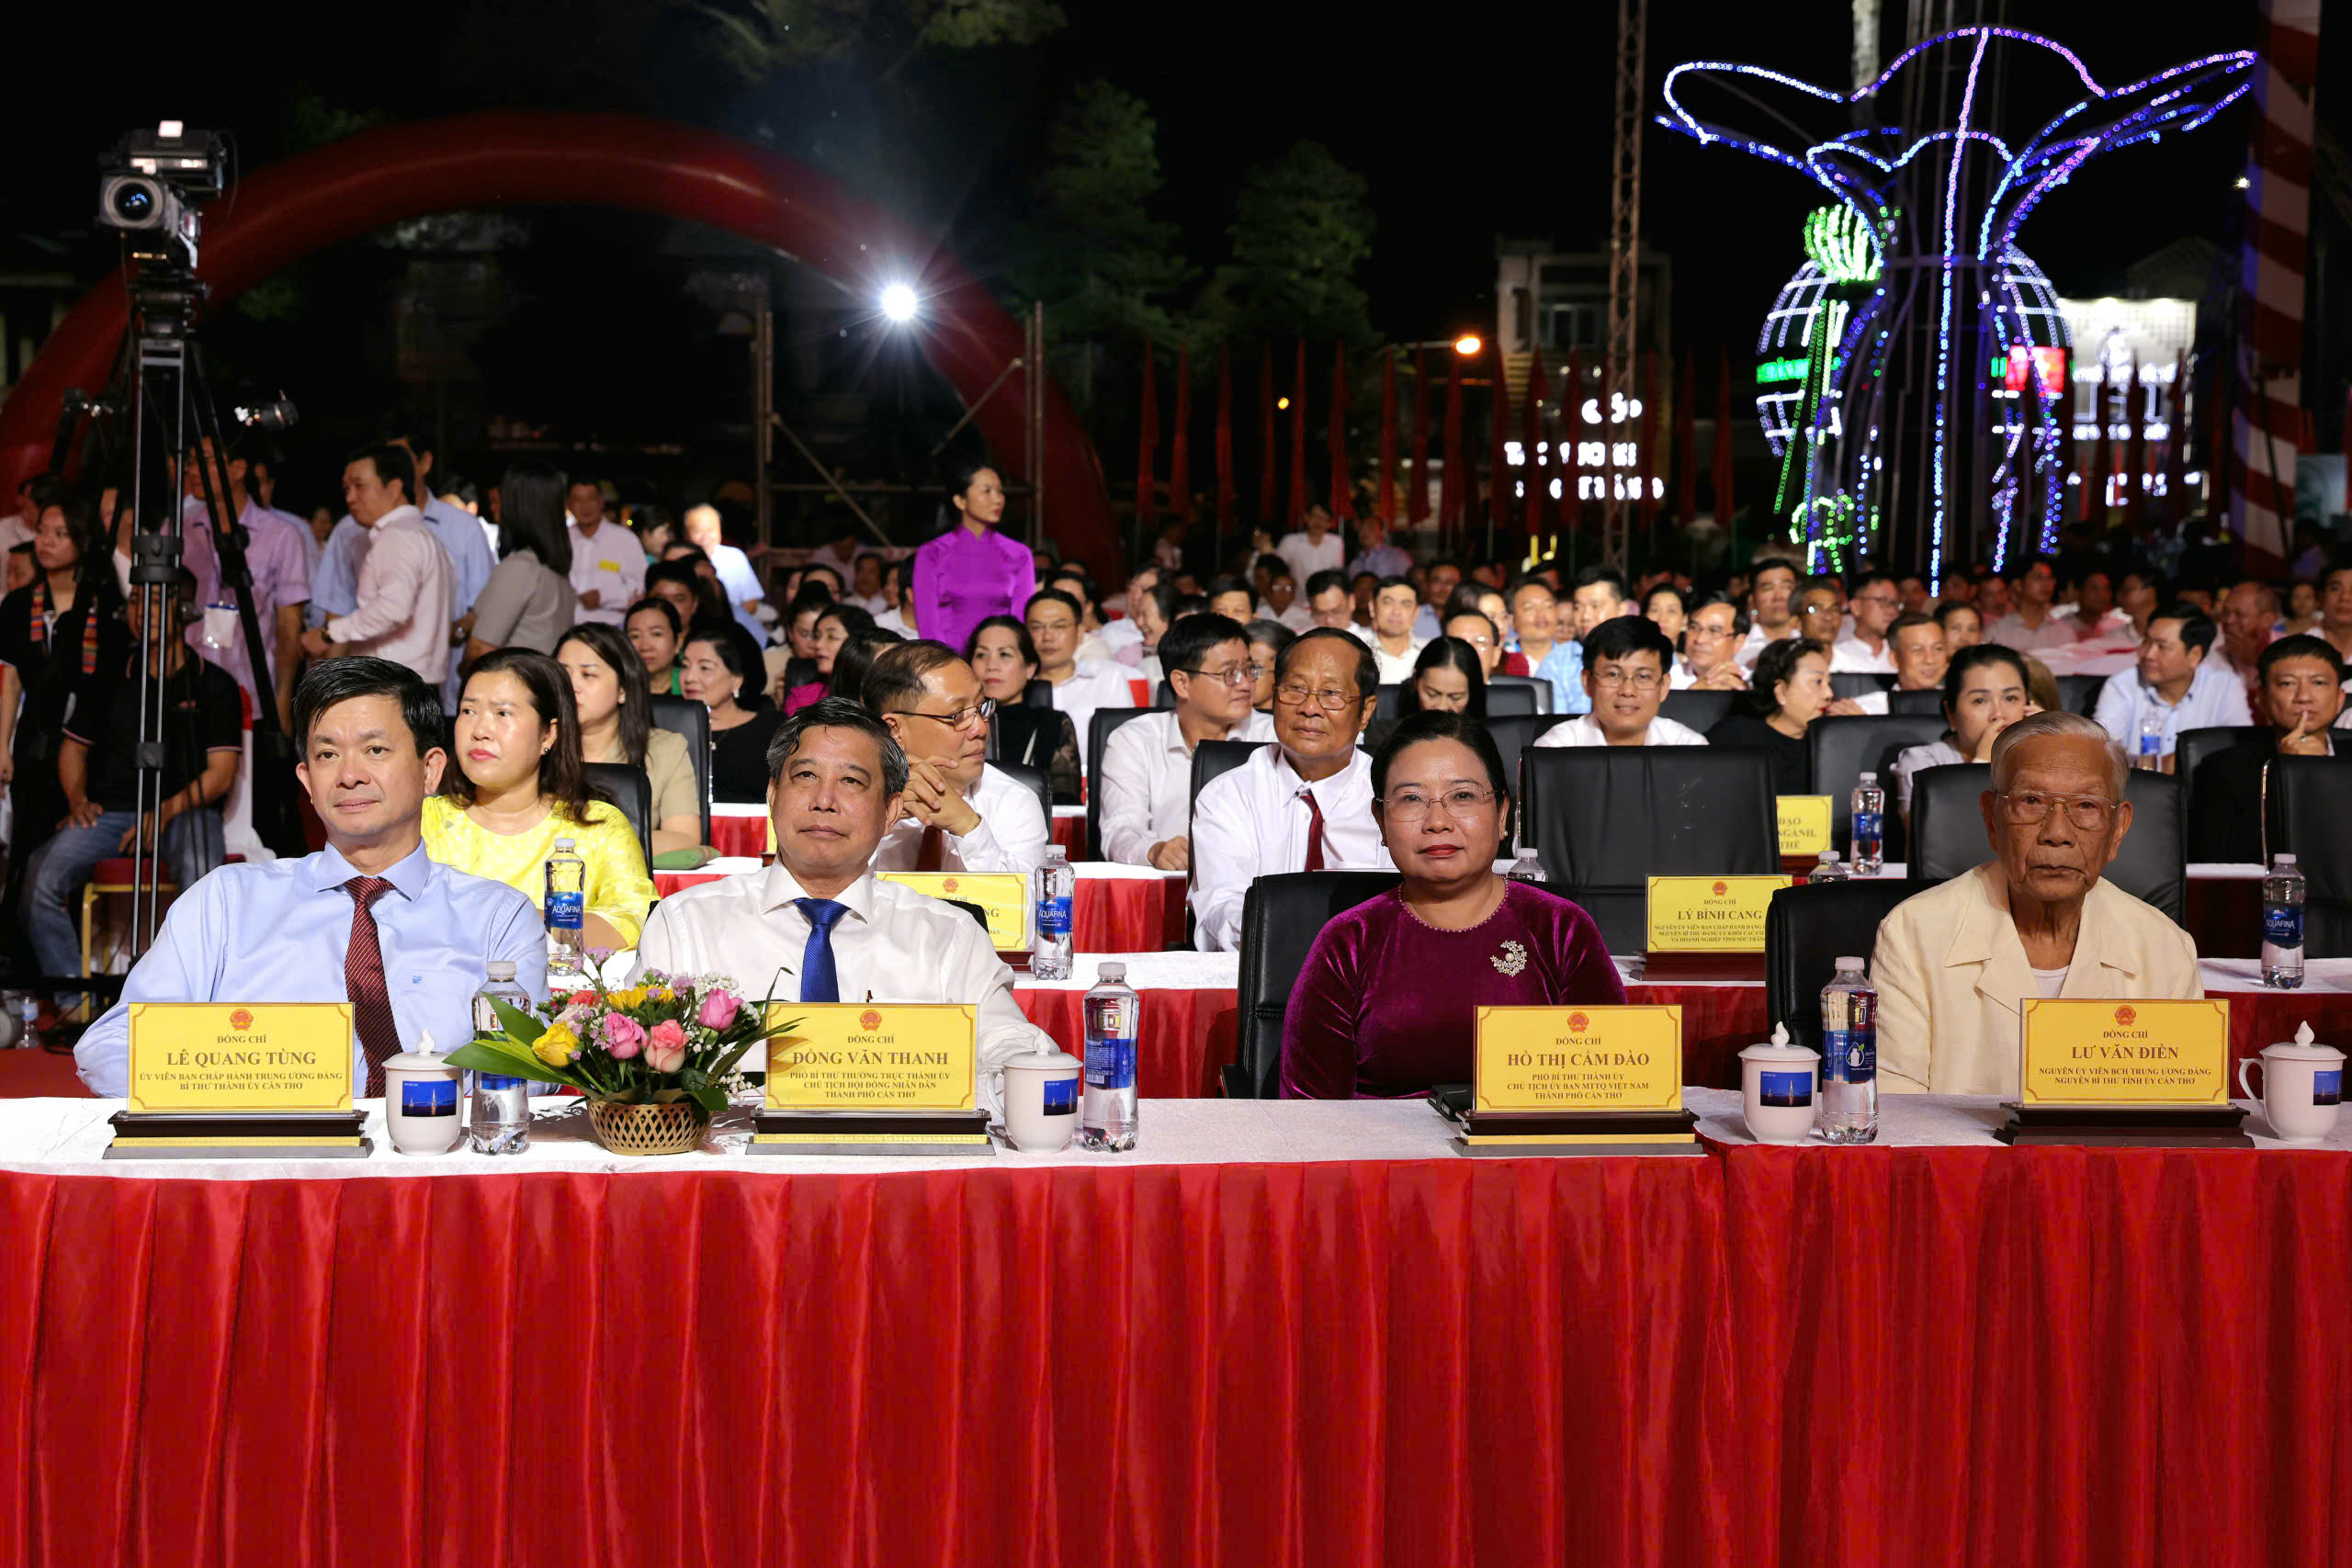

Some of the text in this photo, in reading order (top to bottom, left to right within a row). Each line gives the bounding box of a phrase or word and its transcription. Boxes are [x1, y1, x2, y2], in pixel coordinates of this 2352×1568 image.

[552, 905, 581, 914] AQUAFINA
[1038, 909, 1068, 919] AQUAFINA
[1678, 908, 1762, 920] LÝ BÌNH CANG
[2266, 919, 2295, 929] AQUAFINA
[217, 1034, 266, 1044] ĐỒNG CHÍ
[2103, 1029, 2148, 1039] ĐỒNG CHÍ
[847, 1035, 895, 1044] ĐỒNG CHÍ
[1555, 1036, 1601, 1045] ĐỒNG CHÍ
[2072, 1043, 2178, 1059] LƯ VĂN ĐIỀN
[166, 1048, 317, 1068] LÊ QUANG TÙNG
[793, 1048, 948, 1066] ĐỒNG VĂN THANH
[1508, 1050, 1650, 1069] HỒ THỊ CẨM ĐÀO
